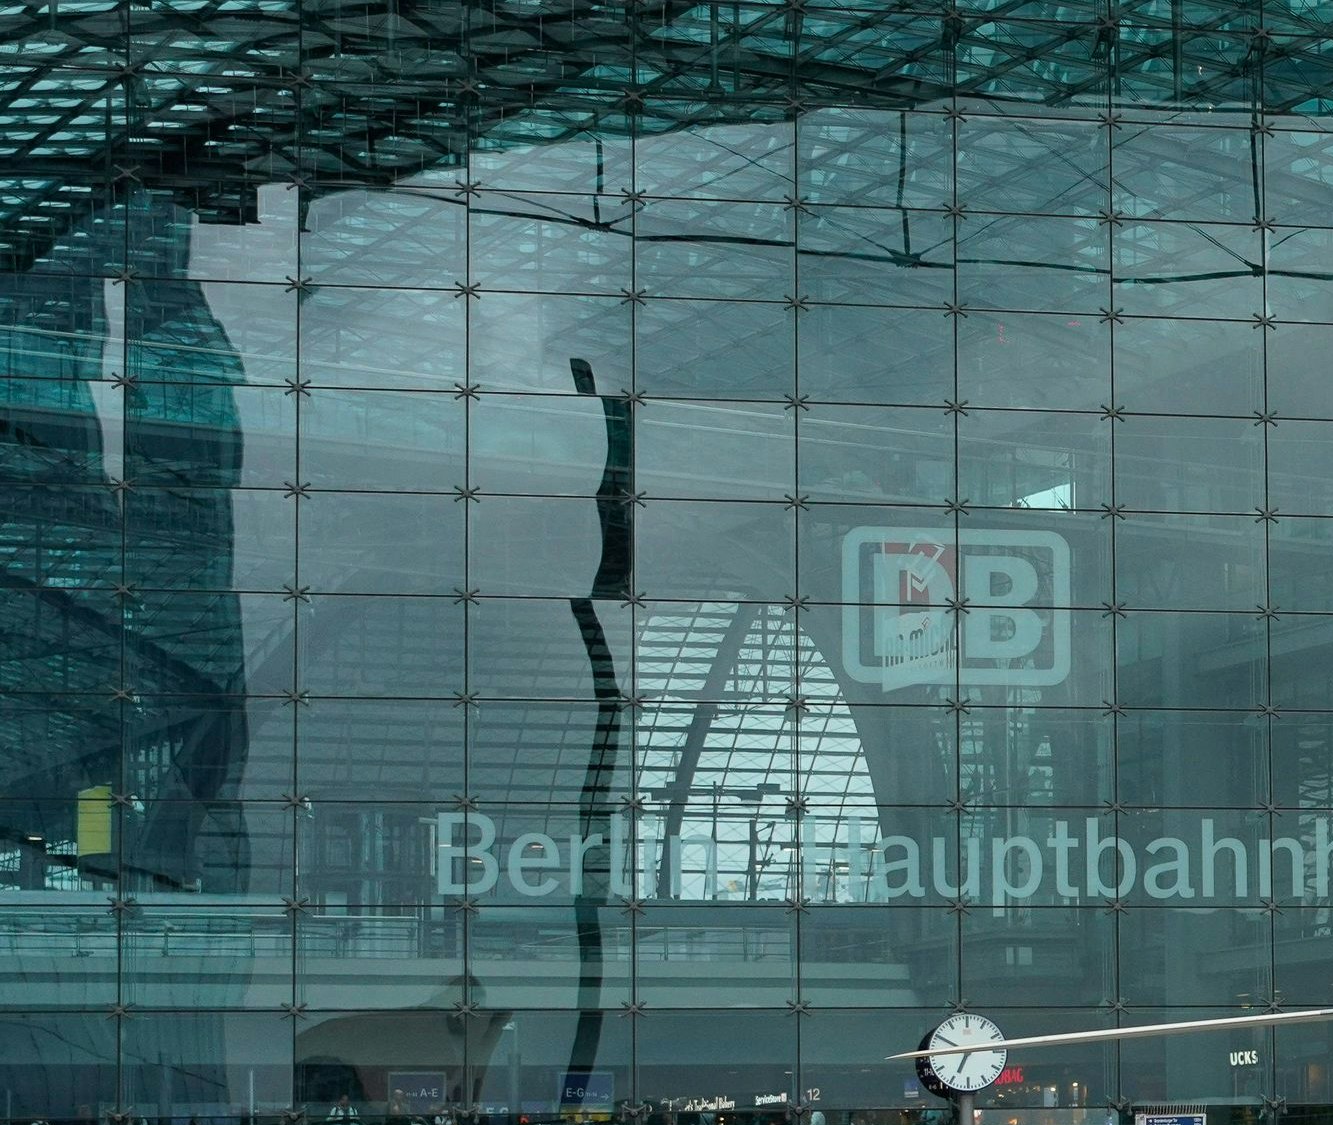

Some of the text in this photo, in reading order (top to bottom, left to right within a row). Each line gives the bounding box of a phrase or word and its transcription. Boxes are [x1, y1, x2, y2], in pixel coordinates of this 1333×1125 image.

[436, 812, 717, 899] Berlin
[566, 1088, 585, 1098] E-G
[806, 1088, 821, 1102] 12
